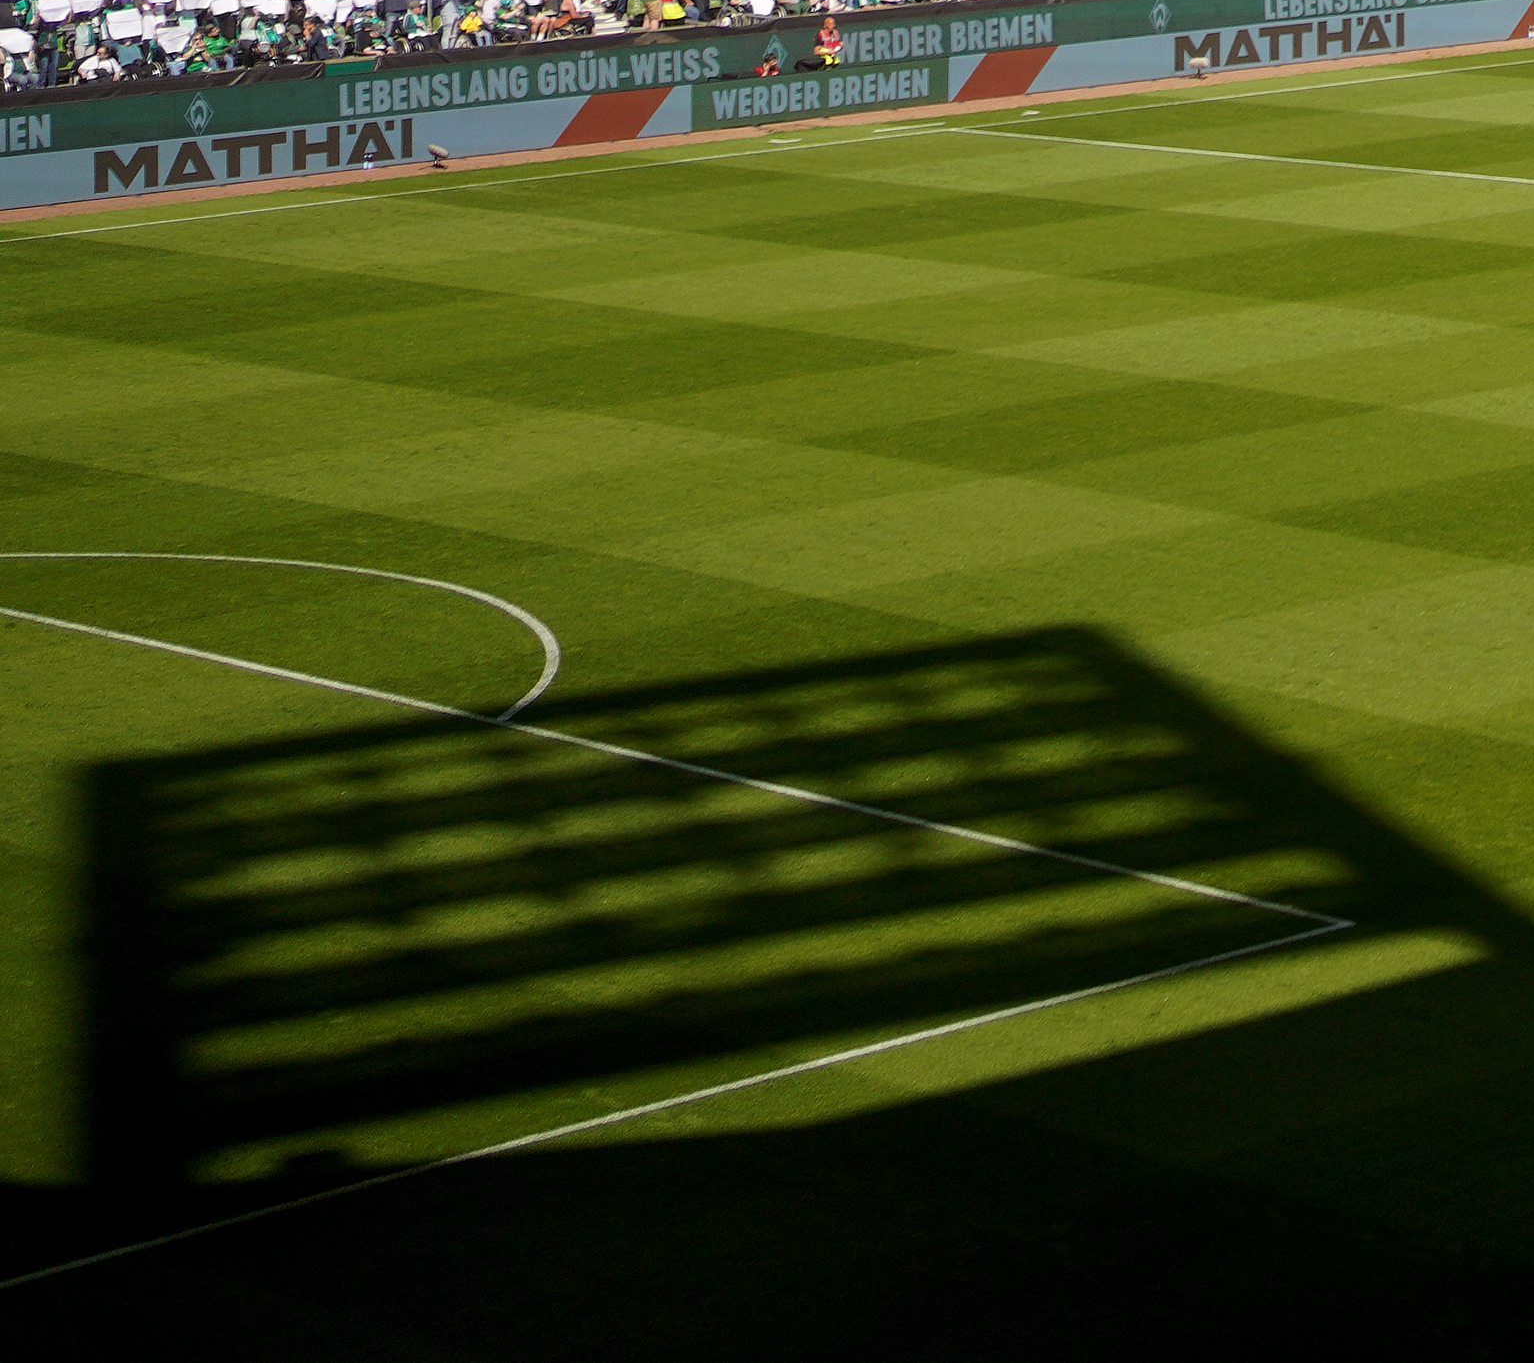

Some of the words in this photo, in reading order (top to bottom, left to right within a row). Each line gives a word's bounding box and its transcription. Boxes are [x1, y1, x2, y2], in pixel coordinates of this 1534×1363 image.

[842, 23, 943, 64] WERDER
[950, 12, 1053, 50] BREMEN
[1174, 13, 1406, 72] MATTHÄI
[339, 63, 529, 118] LEBENSLANG
[536, 46, 721, 96] GRÜN-WEISS
[711, 76, 822, 121] WERDER
[827, 68, 931, 107] BREMEN
[93, 117, 414, 194] MATTHÄI
